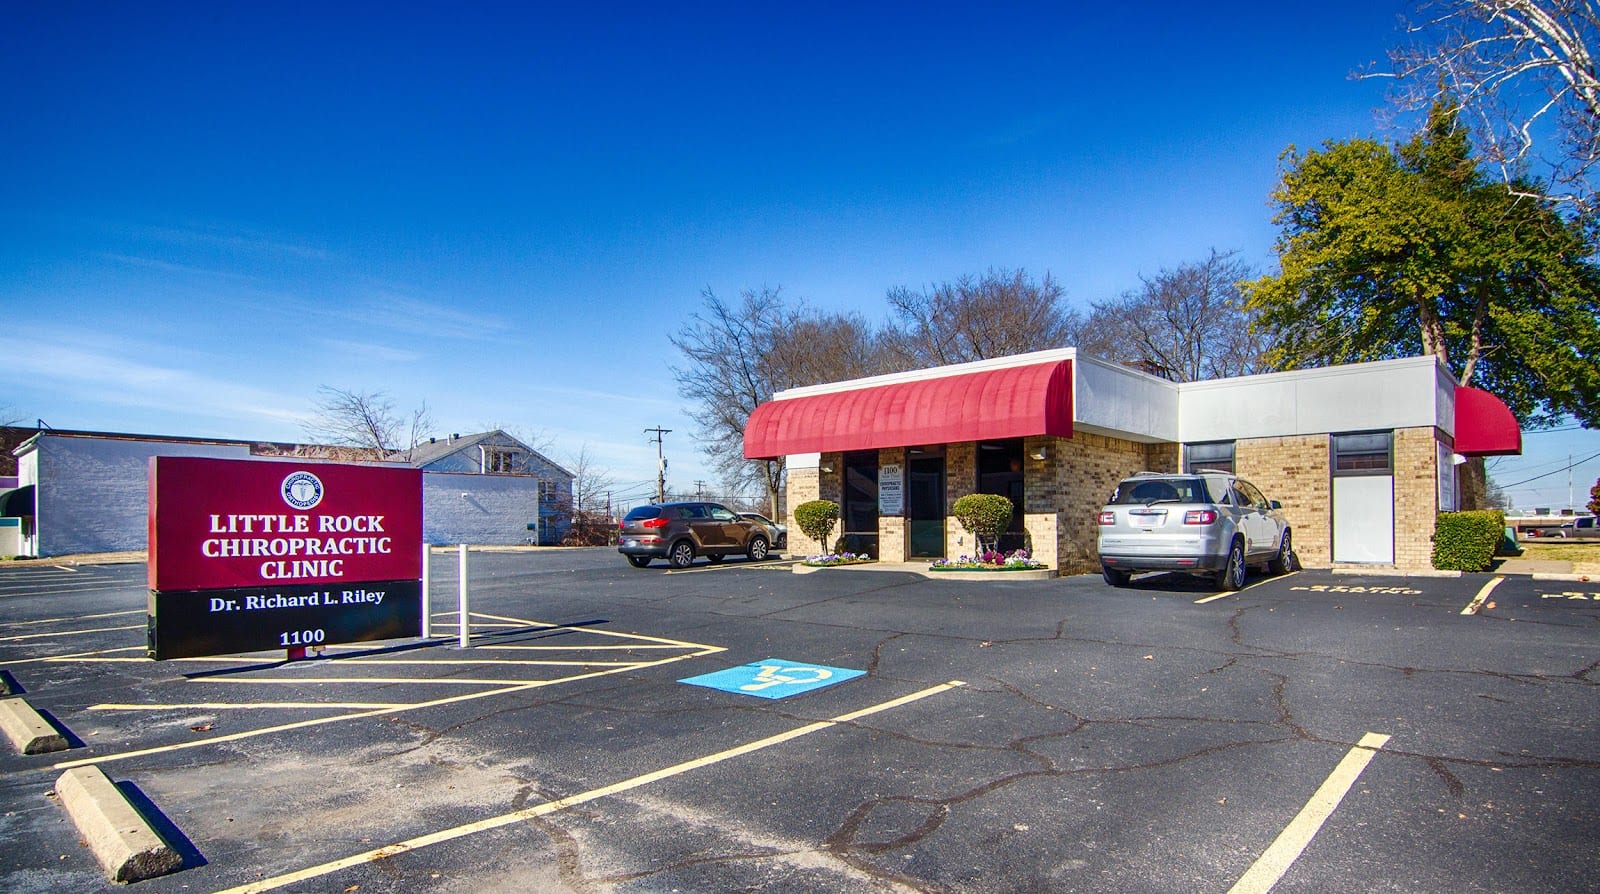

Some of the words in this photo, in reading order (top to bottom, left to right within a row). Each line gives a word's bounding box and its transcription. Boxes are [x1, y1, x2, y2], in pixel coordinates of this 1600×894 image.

[884, 466, 898, 474] 1100
[285, 474, 320, 489] CHIROPRACTIC
[209, 514, 310, 533] LITTLE
[318, 515, 385, 533] ROCK
[202, 537, 392, 558] CHIROPRACTIC
[260, 559, 344, 579] CLINIC
[210, 597, 241, 612] Dr.
[246, 593, 319, 611] Richard
[323, 592, 338, 605] L.
[342, 589, 386, 605] Riley
[279, 629, 325, 647] 1100
